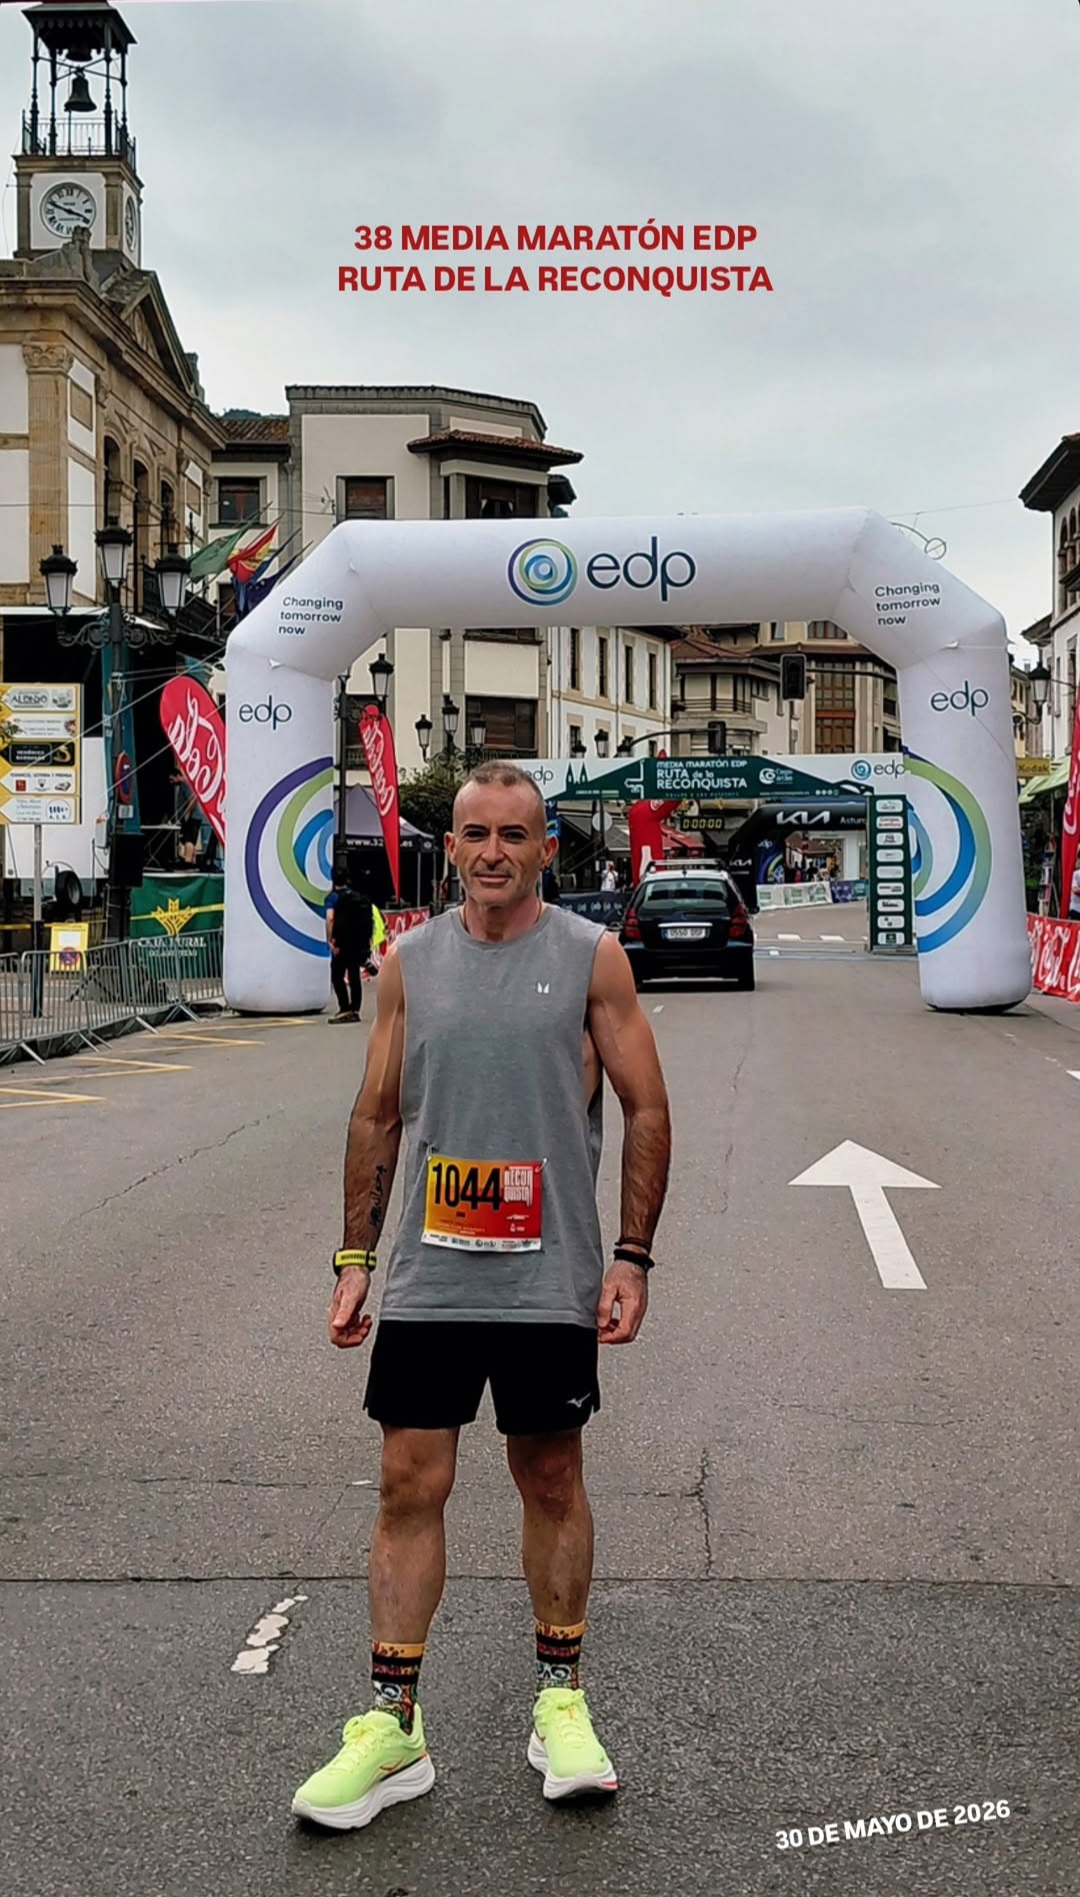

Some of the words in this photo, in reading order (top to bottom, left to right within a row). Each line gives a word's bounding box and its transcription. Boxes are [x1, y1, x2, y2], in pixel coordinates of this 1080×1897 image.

[586, 535, 697, 602] edp
[874, 582, 941, 598] Changing
[282, 596, 344, 611] Changing
[876, 597, 941, 612] tomorrow
[280, 611, 342, 623] tomorrow
[877, 615, 906, 626] now
[278, 625, 306, 635] now
[930, 680, 989, 717] edp
[238, 695, 293, 731] edp
[656, 760, 684, 768] MEDIA
[685, 759, 729, 768] MARATÓN
[730, 760, 748, 768] EDP
[873, 759, 905, 779] edp
[1018, 763, 1049, 773] Kodak
[656, 769, 689, 779] RUTA
[692, 770, 703, 779] de
[705, 770, 714, 778] la
[656, 778, 748, 791] RECONQUISTA
[776, 810, 831, 824] KIA
[432, 1161, 504, 1212] 1044
